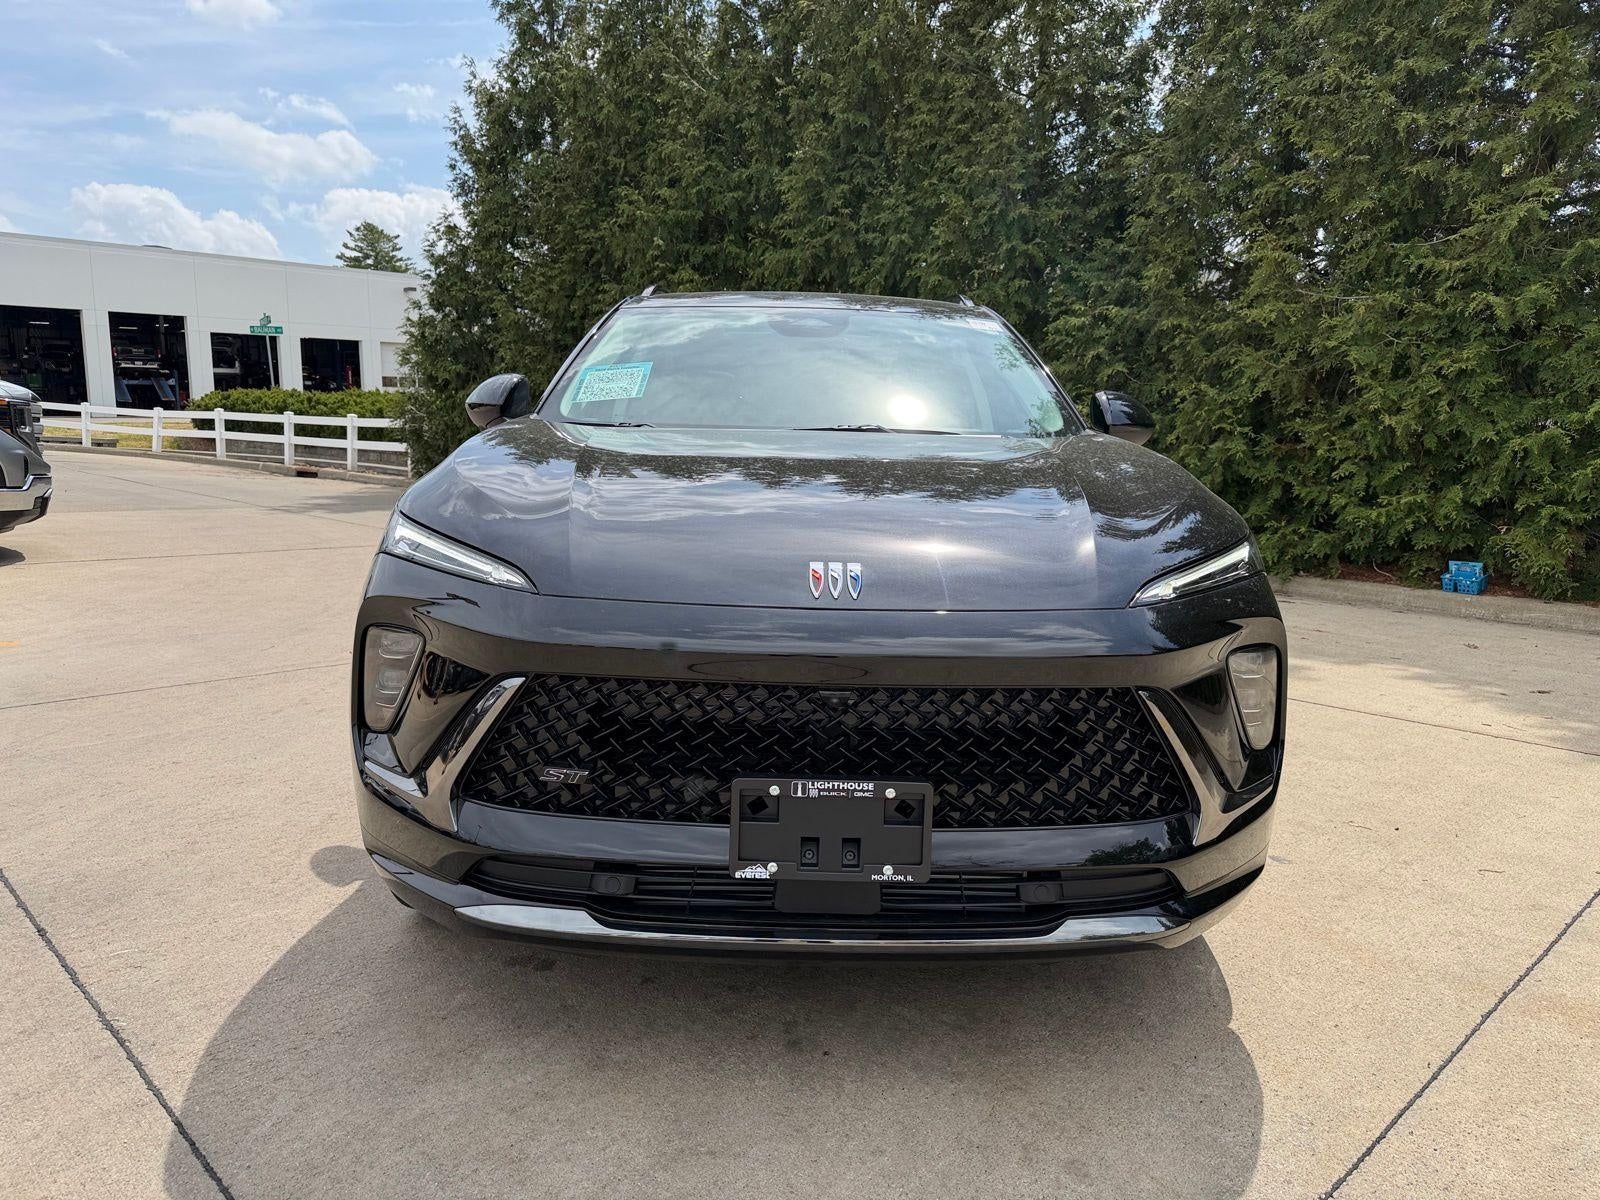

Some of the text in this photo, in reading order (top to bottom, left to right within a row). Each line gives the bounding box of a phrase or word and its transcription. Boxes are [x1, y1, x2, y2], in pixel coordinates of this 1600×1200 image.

[539, 768, 589, 783] ST
[808, 781, 875, 791] LIGHTHOUSE
[734, 869, 770, 880] everest
[871, 874, 906, 882] MORTON,
